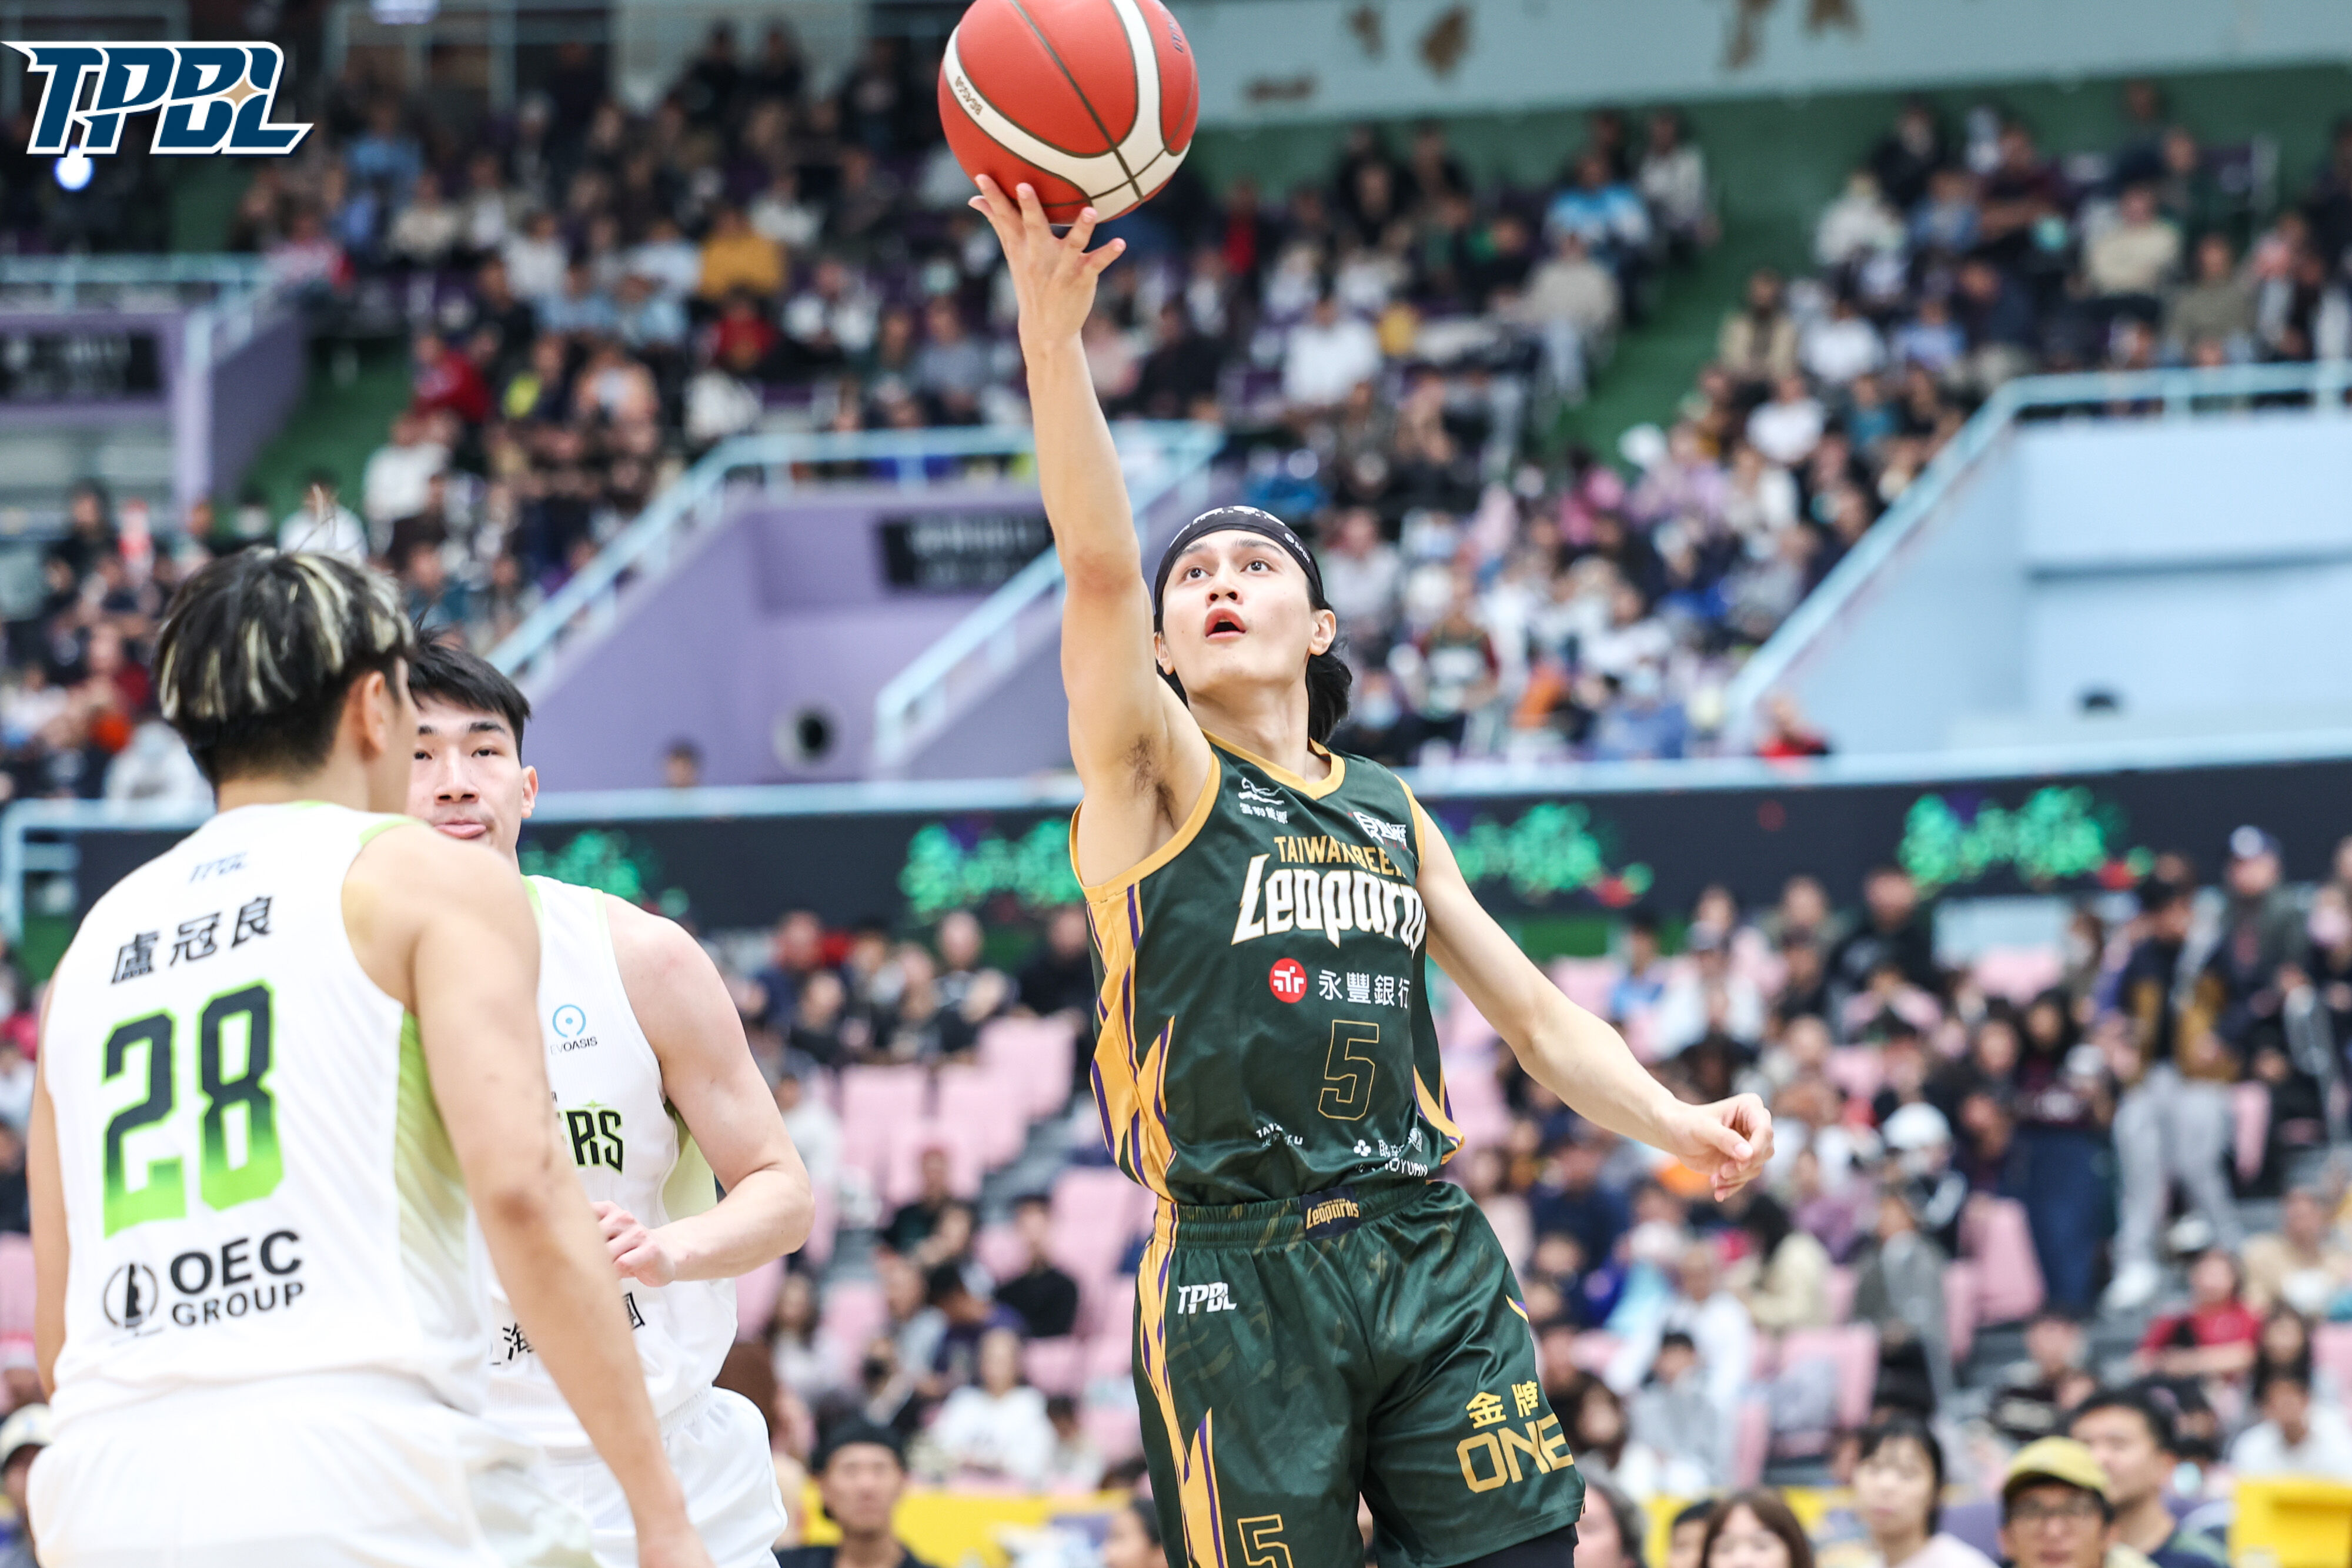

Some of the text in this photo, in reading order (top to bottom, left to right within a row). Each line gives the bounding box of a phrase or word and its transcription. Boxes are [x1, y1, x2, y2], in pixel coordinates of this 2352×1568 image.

[111, 896, 273, 985] 盧冠良
[1319, 969, 1410, 1009] 永豐銀行
[1318, 1019, 1379, 1121] 5
[101, 979, 285, 1240] 28
[1306, 1199, 1359, 1230] Leopards
[170, 1230, 302, 1296] OEC
[172, 1282, 304, 1327] GROUP
[1177, 1282, 1237, 1315] TPBL
[1466, 1380, 1539, 1429] 金牌
[1456, 1413, 1575, 1493] ONE
